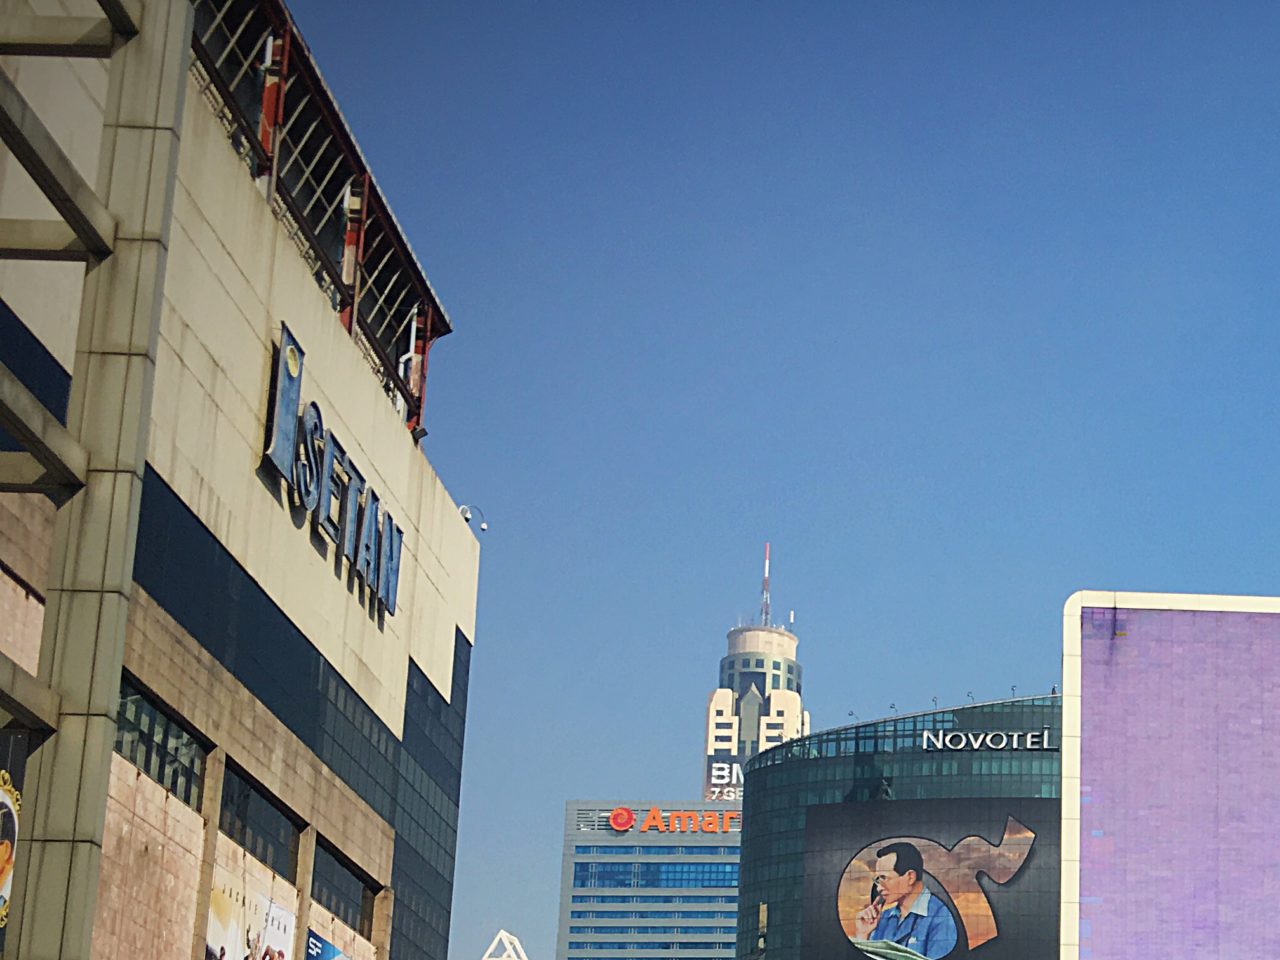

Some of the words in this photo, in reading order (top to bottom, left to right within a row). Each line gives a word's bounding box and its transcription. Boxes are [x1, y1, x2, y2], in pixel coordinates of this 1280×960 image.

[265, 320, 404, 616] ISETAN
[922, 727, 1059, 751] NOVOTEL
[640, 806, 743, 833] Amar
